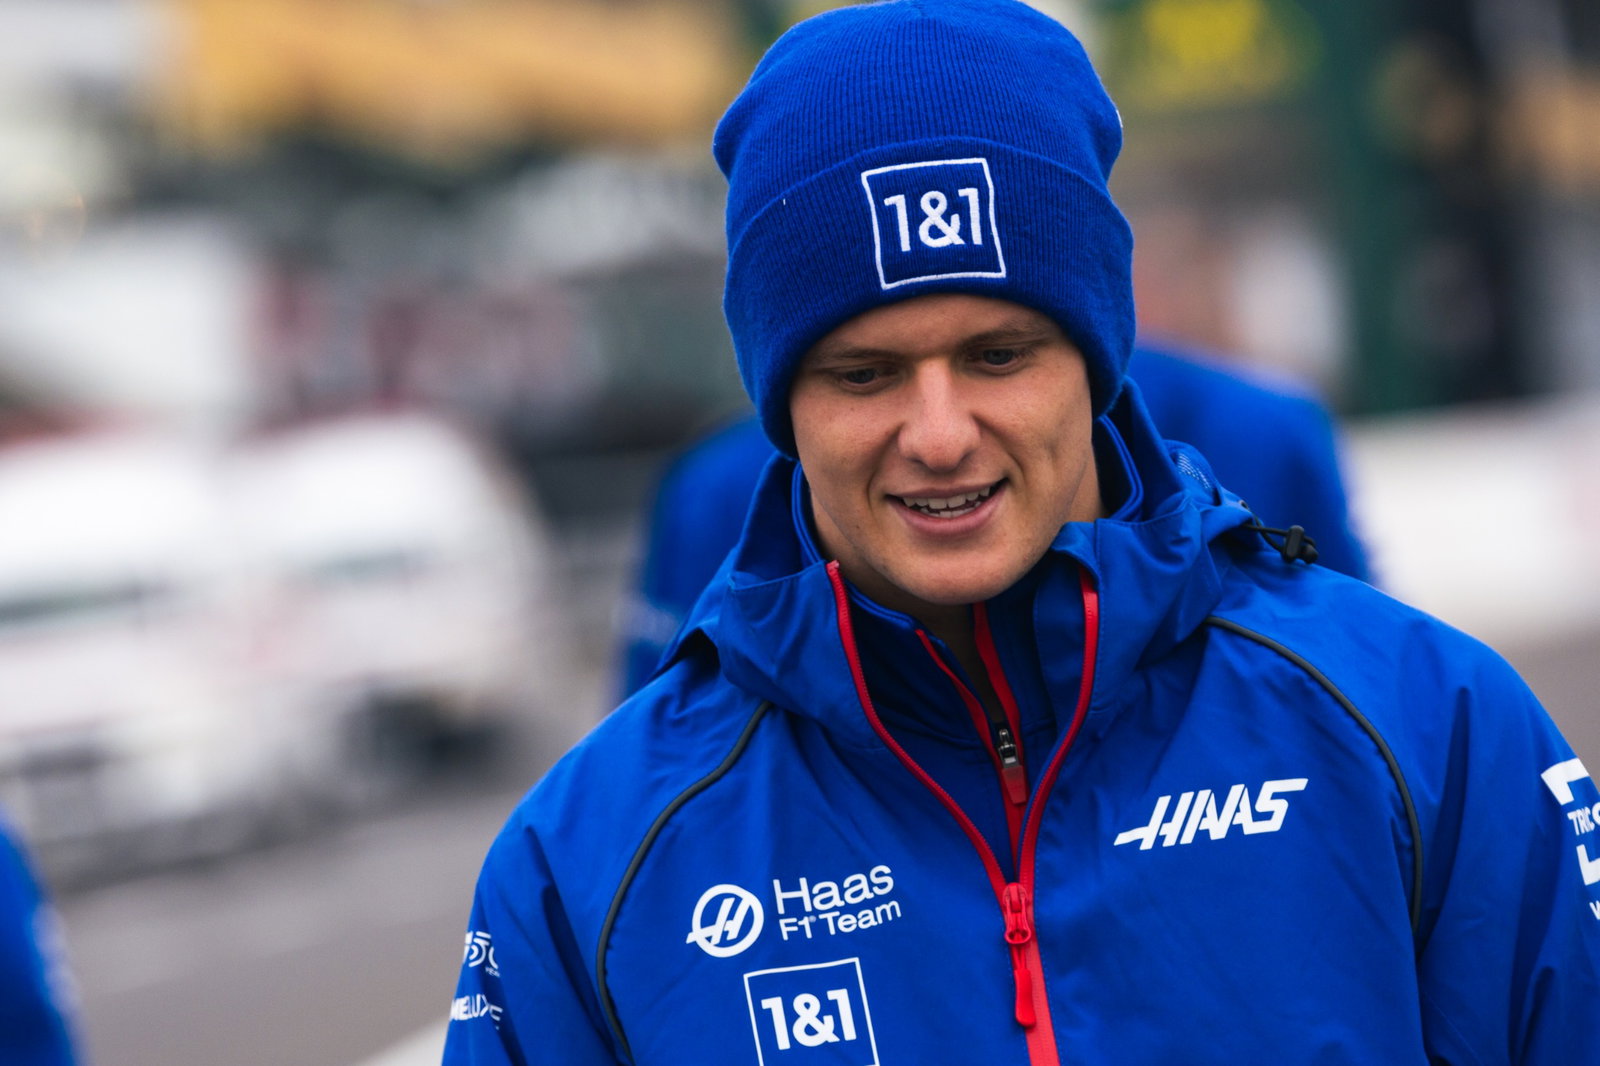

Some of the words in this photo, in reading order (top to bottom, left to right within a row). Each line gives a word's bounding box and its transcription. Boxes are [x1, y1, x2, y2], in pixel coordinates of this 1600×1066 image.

[883, 187, 983, 252] 1&1
[1114, 778, 1308, 850] HAAS
[773, 865, 894, 914] Haas
[819, 901, 901, 935] Team
[761, 988, 857, 1050] 1&1
